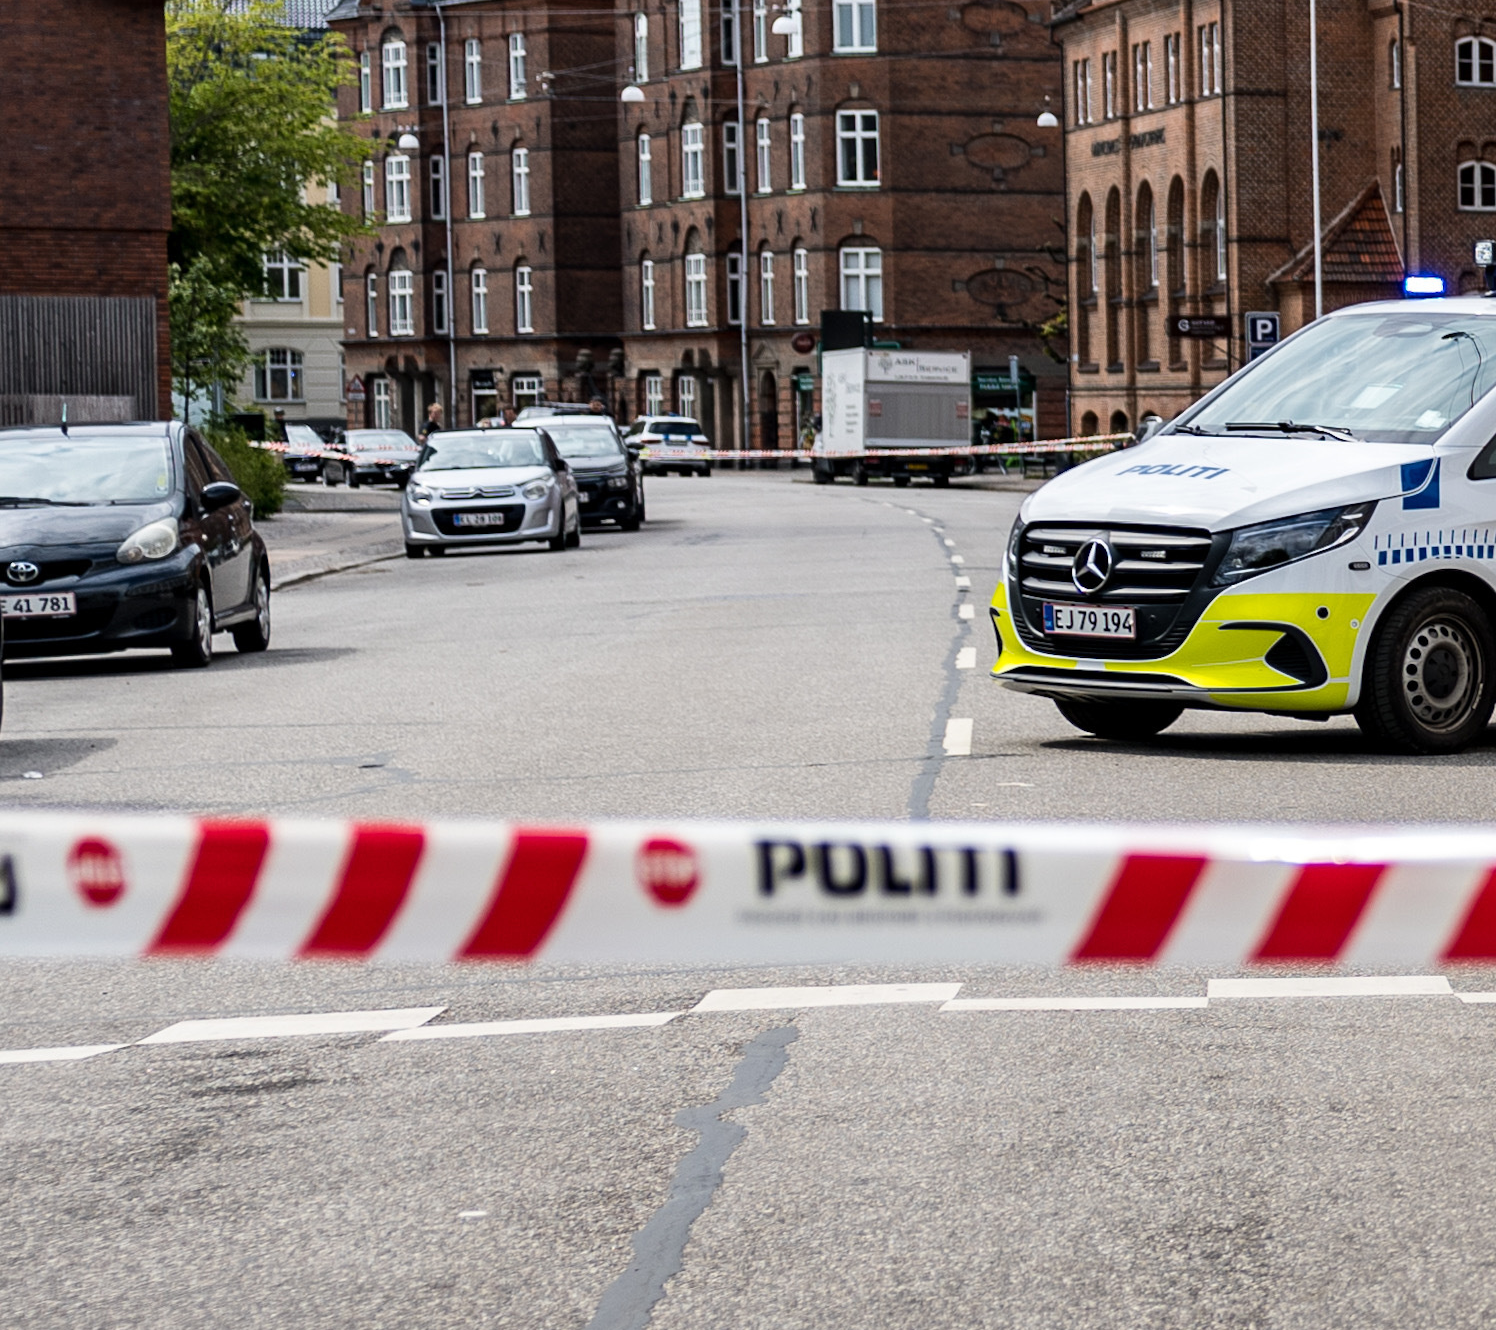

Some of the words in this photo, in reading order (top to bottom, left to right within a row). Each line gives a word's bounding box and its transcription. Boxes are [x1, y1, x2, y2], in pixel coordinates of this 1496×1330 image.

[1256, 319, 1273, 341] P
[1114, 463, 1231, 480] POLITI
[13, 599, 33, 613] 41
[39, 596, 71, 612] 781
[1054, 609, 1074, 630] EJ
[1078, 610, 1098, 631] 79
[1102, 611, 1133, 633] 194
[753, 838, 1024, 898] POLITI
